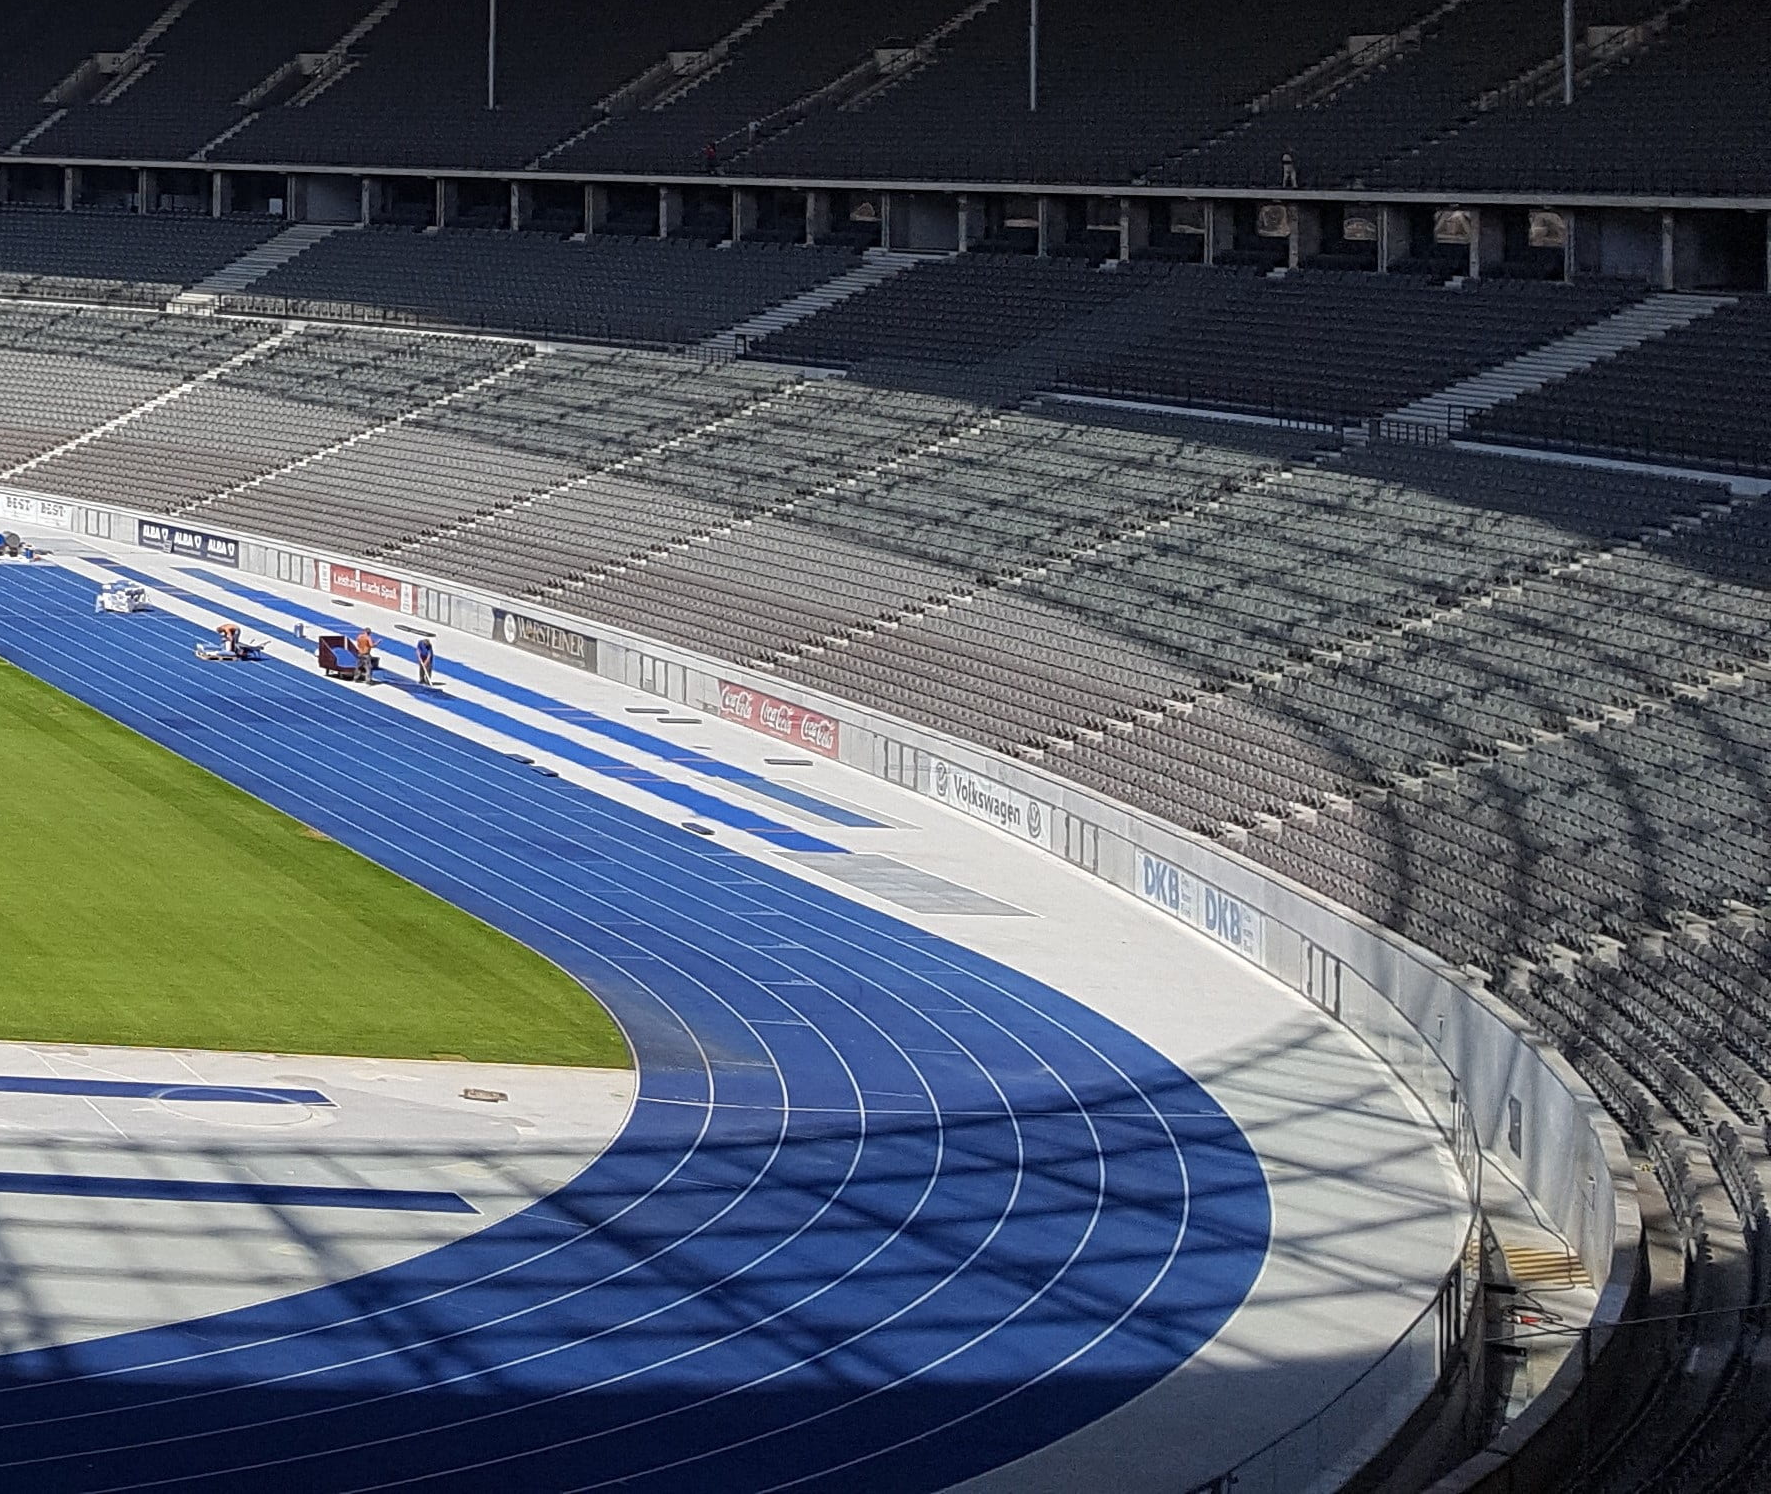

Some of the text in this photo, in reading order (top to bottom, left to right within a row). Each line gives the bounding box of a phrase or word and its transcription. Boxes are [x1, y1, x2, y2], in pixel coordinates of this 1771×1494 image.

[174, 531, 194, 547] ALBA
[207, 538, 227, 555] ALBA
[517, 616, 585, 658] WARSTEINER
[953, 774, 1020, 825] Volkswagen
[1143, 854, 1179, 910] DKB
[1204, 887, 1241, 945] DKB
